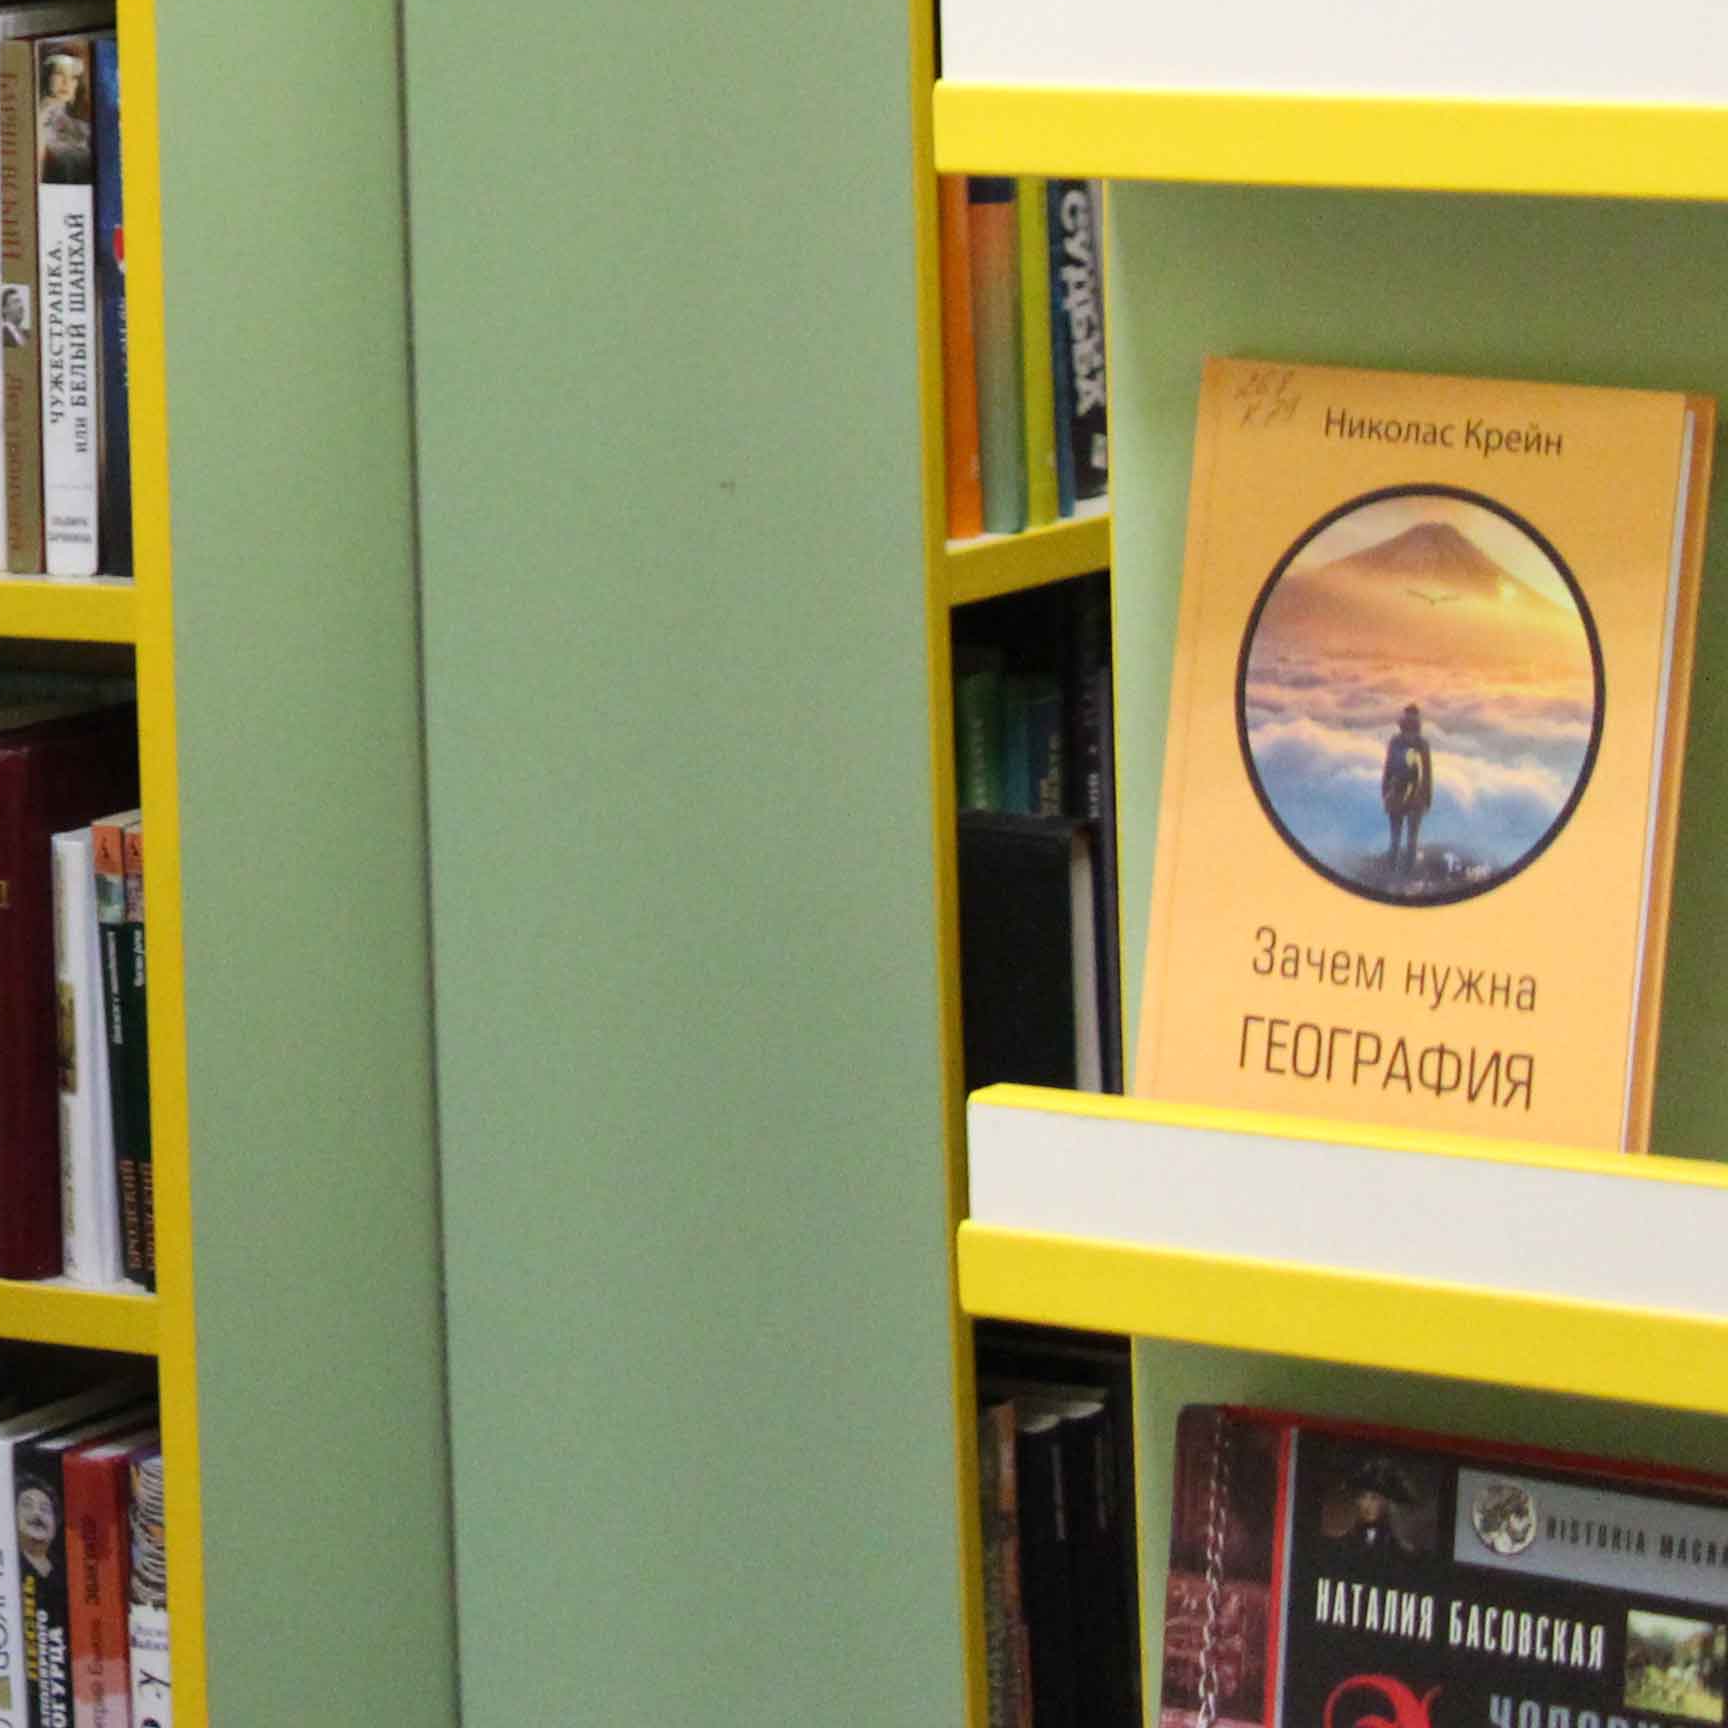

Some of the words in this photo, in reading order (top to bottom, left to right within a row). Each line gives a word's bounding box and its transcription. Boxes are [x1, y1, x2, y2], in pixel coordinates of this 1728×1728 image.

[64, 213, 86, 313] ШАНХАЙ
[69, 323, 88, 407] БЕЛЫЙ
[74, 417, 89, 453] или
[1324, 407, 1455, 448] Николас
[1464, 418, 1563, 458] Крейн
[1249, 927, 1386, 993] Зачем
[1404, 957, 1538, 1014] нужна
[1238, 1014, 1536, 1111] ГЕОГРАФИЯ
[1546, 1517, 1645, 1552] HISTORIA
[23, 1576, 37, 1680] ПЕСНЬ
[1316, 1577, 1434, 1640] НАТАЛИЯ
[1449, 1601, 1606, 1670] БАСОВСКАЯ
